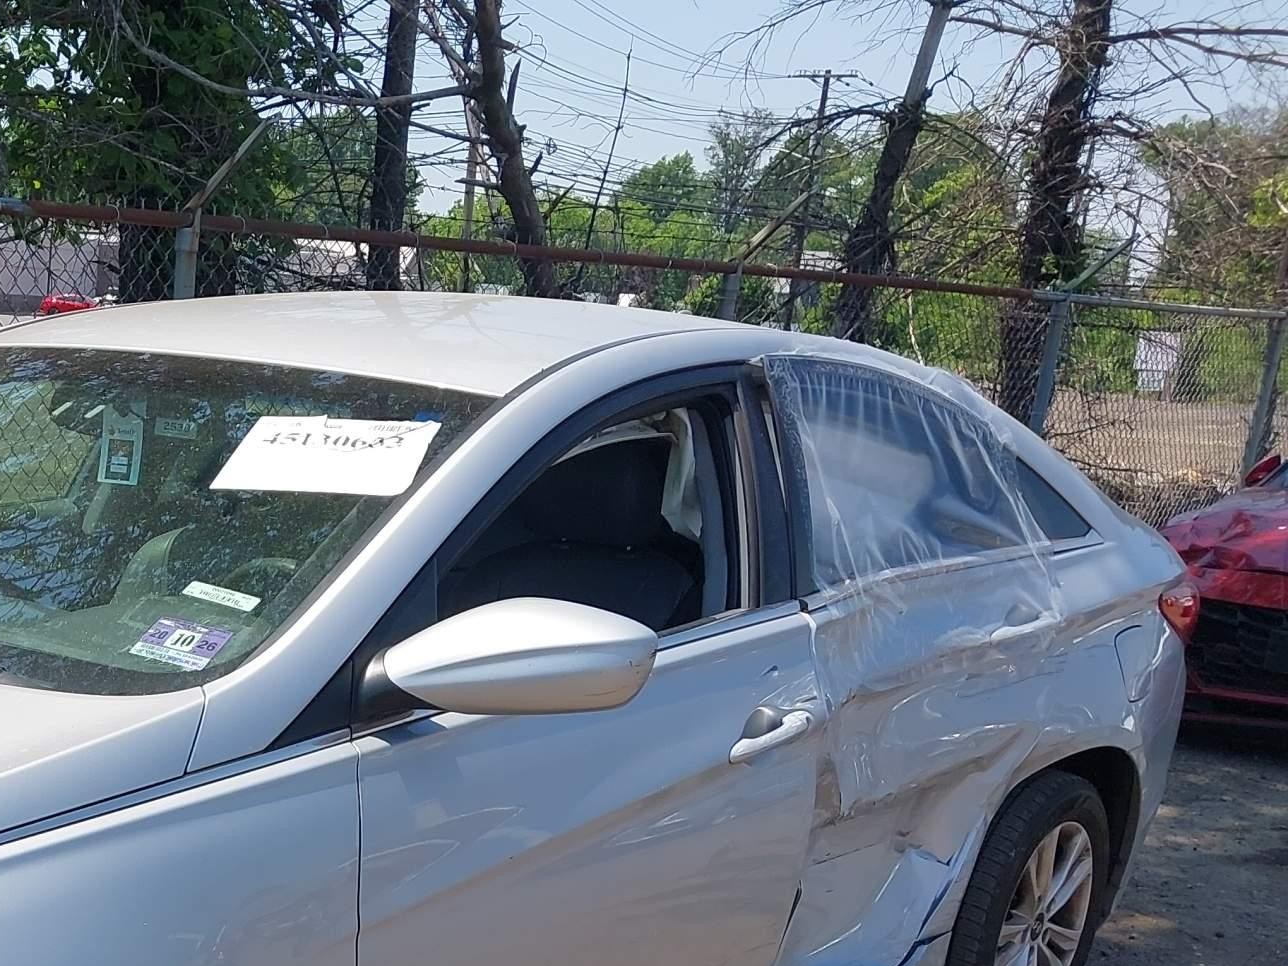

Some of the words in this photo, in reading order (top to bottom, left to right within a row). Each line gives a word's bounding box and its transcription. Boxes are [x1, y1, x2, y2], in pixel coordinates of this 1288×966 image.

[150, 628, 169, 640] 20
[170, 633, 196, 648] 10
[196, 640, 218, 652] 26
